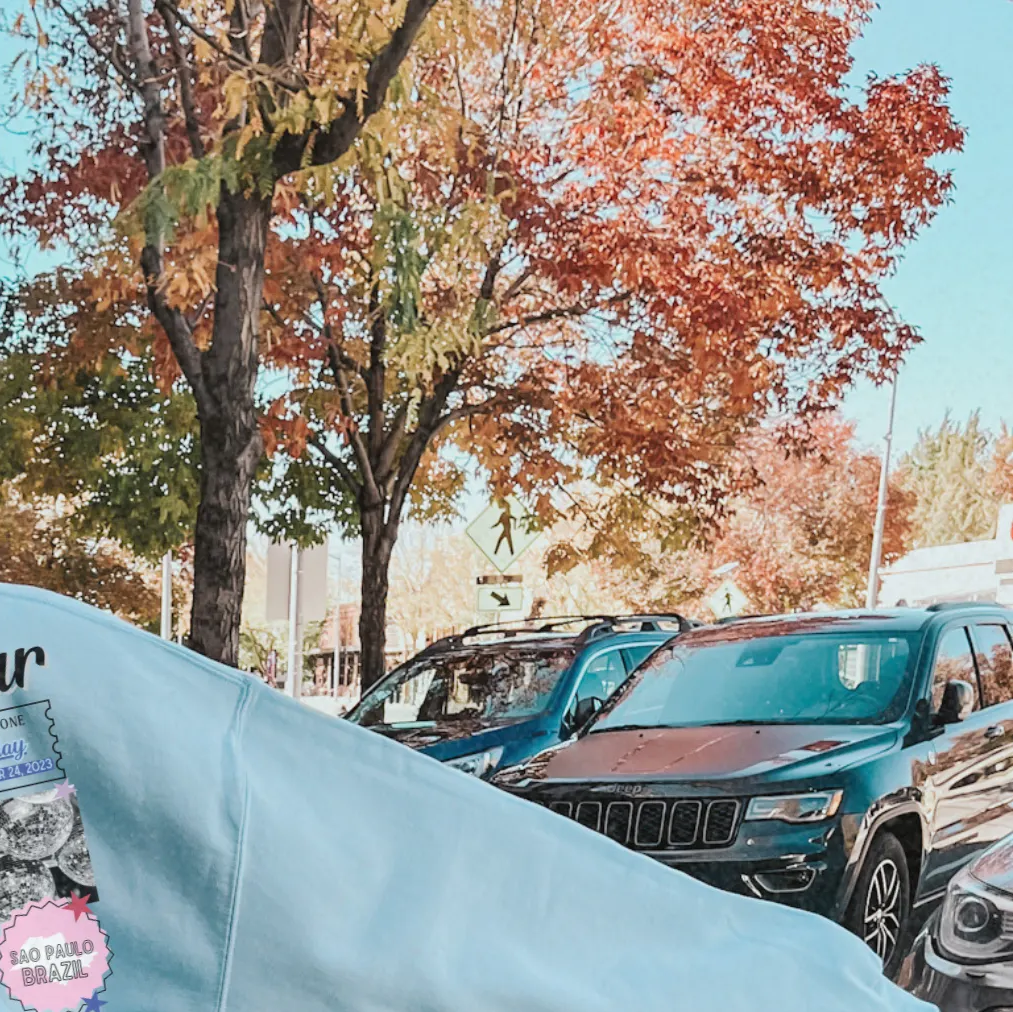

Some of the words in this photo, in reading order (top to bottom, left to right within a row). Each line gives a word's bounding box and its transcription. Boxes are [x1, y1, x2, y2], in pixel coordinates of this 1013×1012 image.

[0, 714, 26, 730] ONE
[8, 765, 24, 777] 24,
[26, 758, 53, 774] 2023
[44, 939, 95, 961] PAULO
[21, 959, 89, 987] BRAZIL
